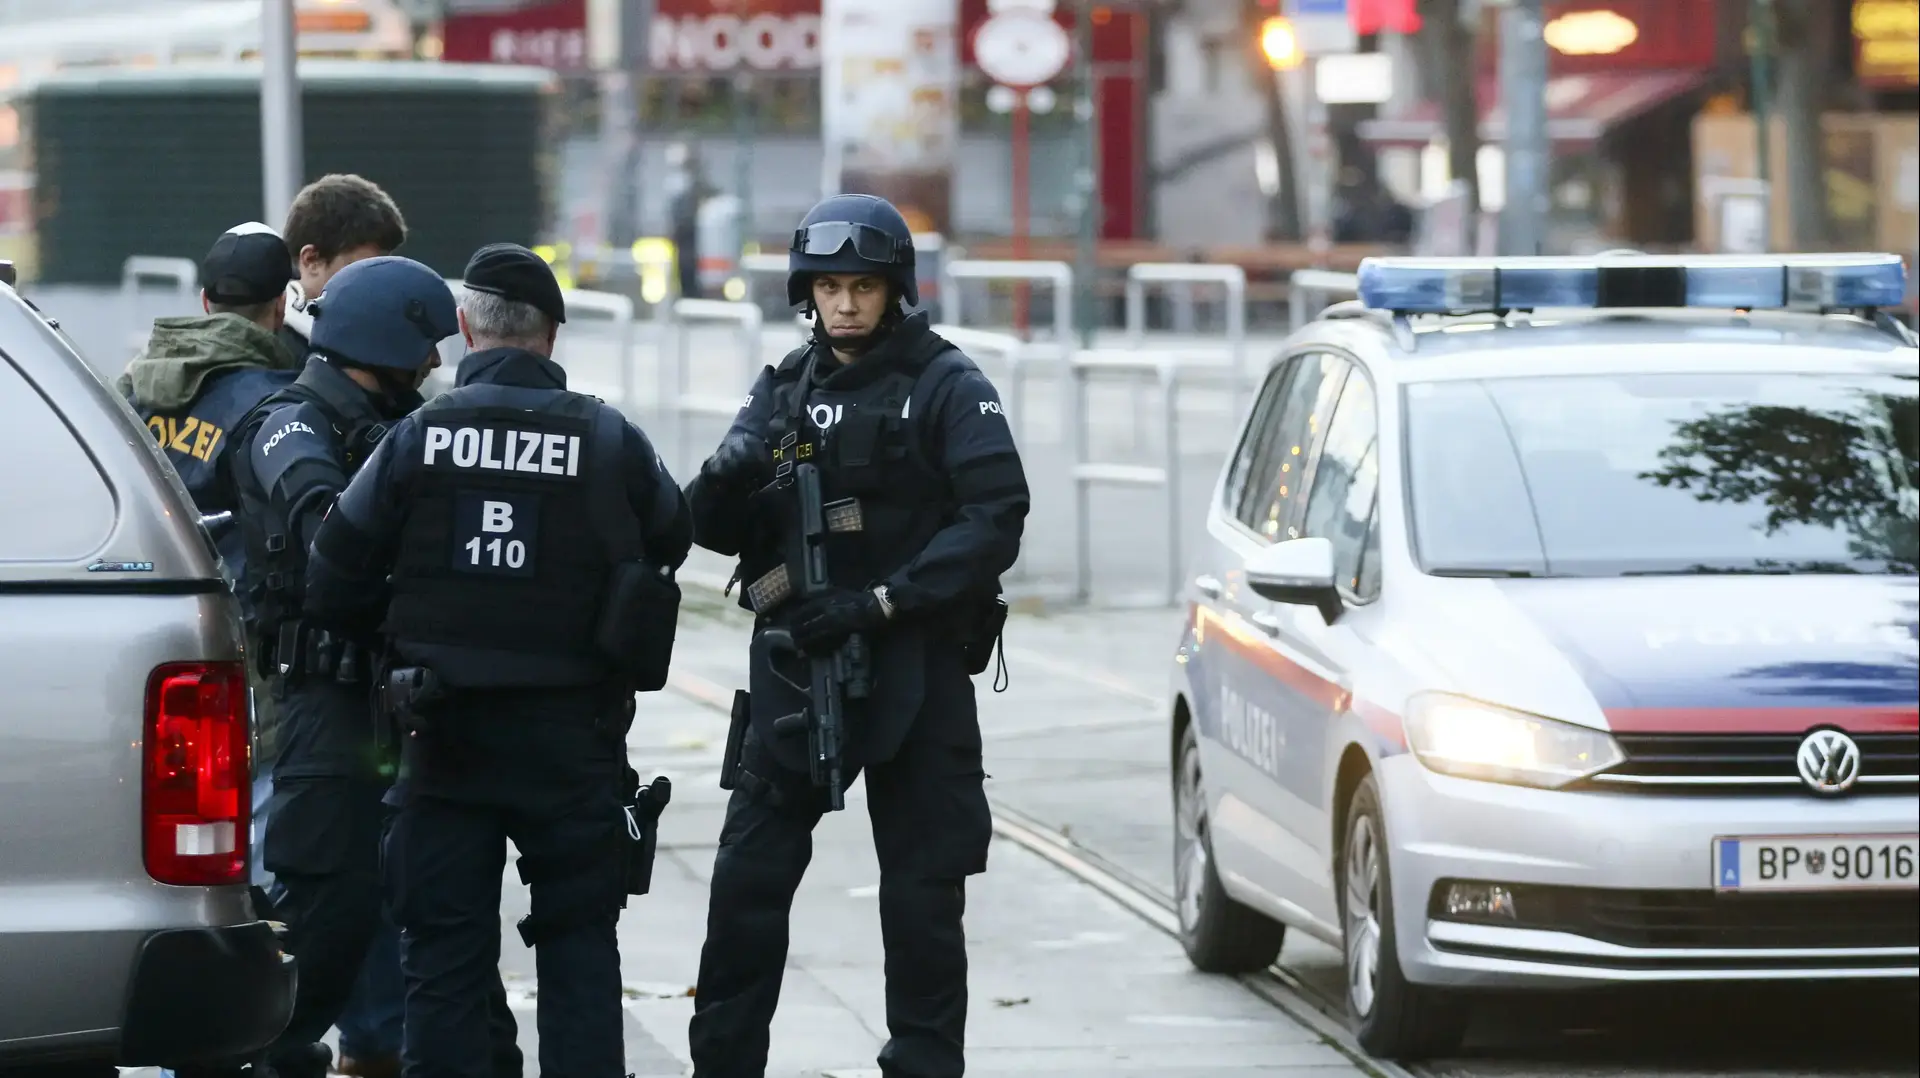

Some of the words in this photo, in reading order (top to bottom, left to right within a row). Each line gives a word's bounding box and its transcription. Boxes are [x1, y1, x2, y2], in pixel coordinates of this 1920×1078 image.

[263, 421, 315, 456] POLIZEI
[423, 426, 581, 477] POLIZEI
[482, 500, 514, 533] B
[465, 536, 526, 569] 110
[1758, 846, 1800, 880] BP
[1832, 845, 1914, 880] 9016
